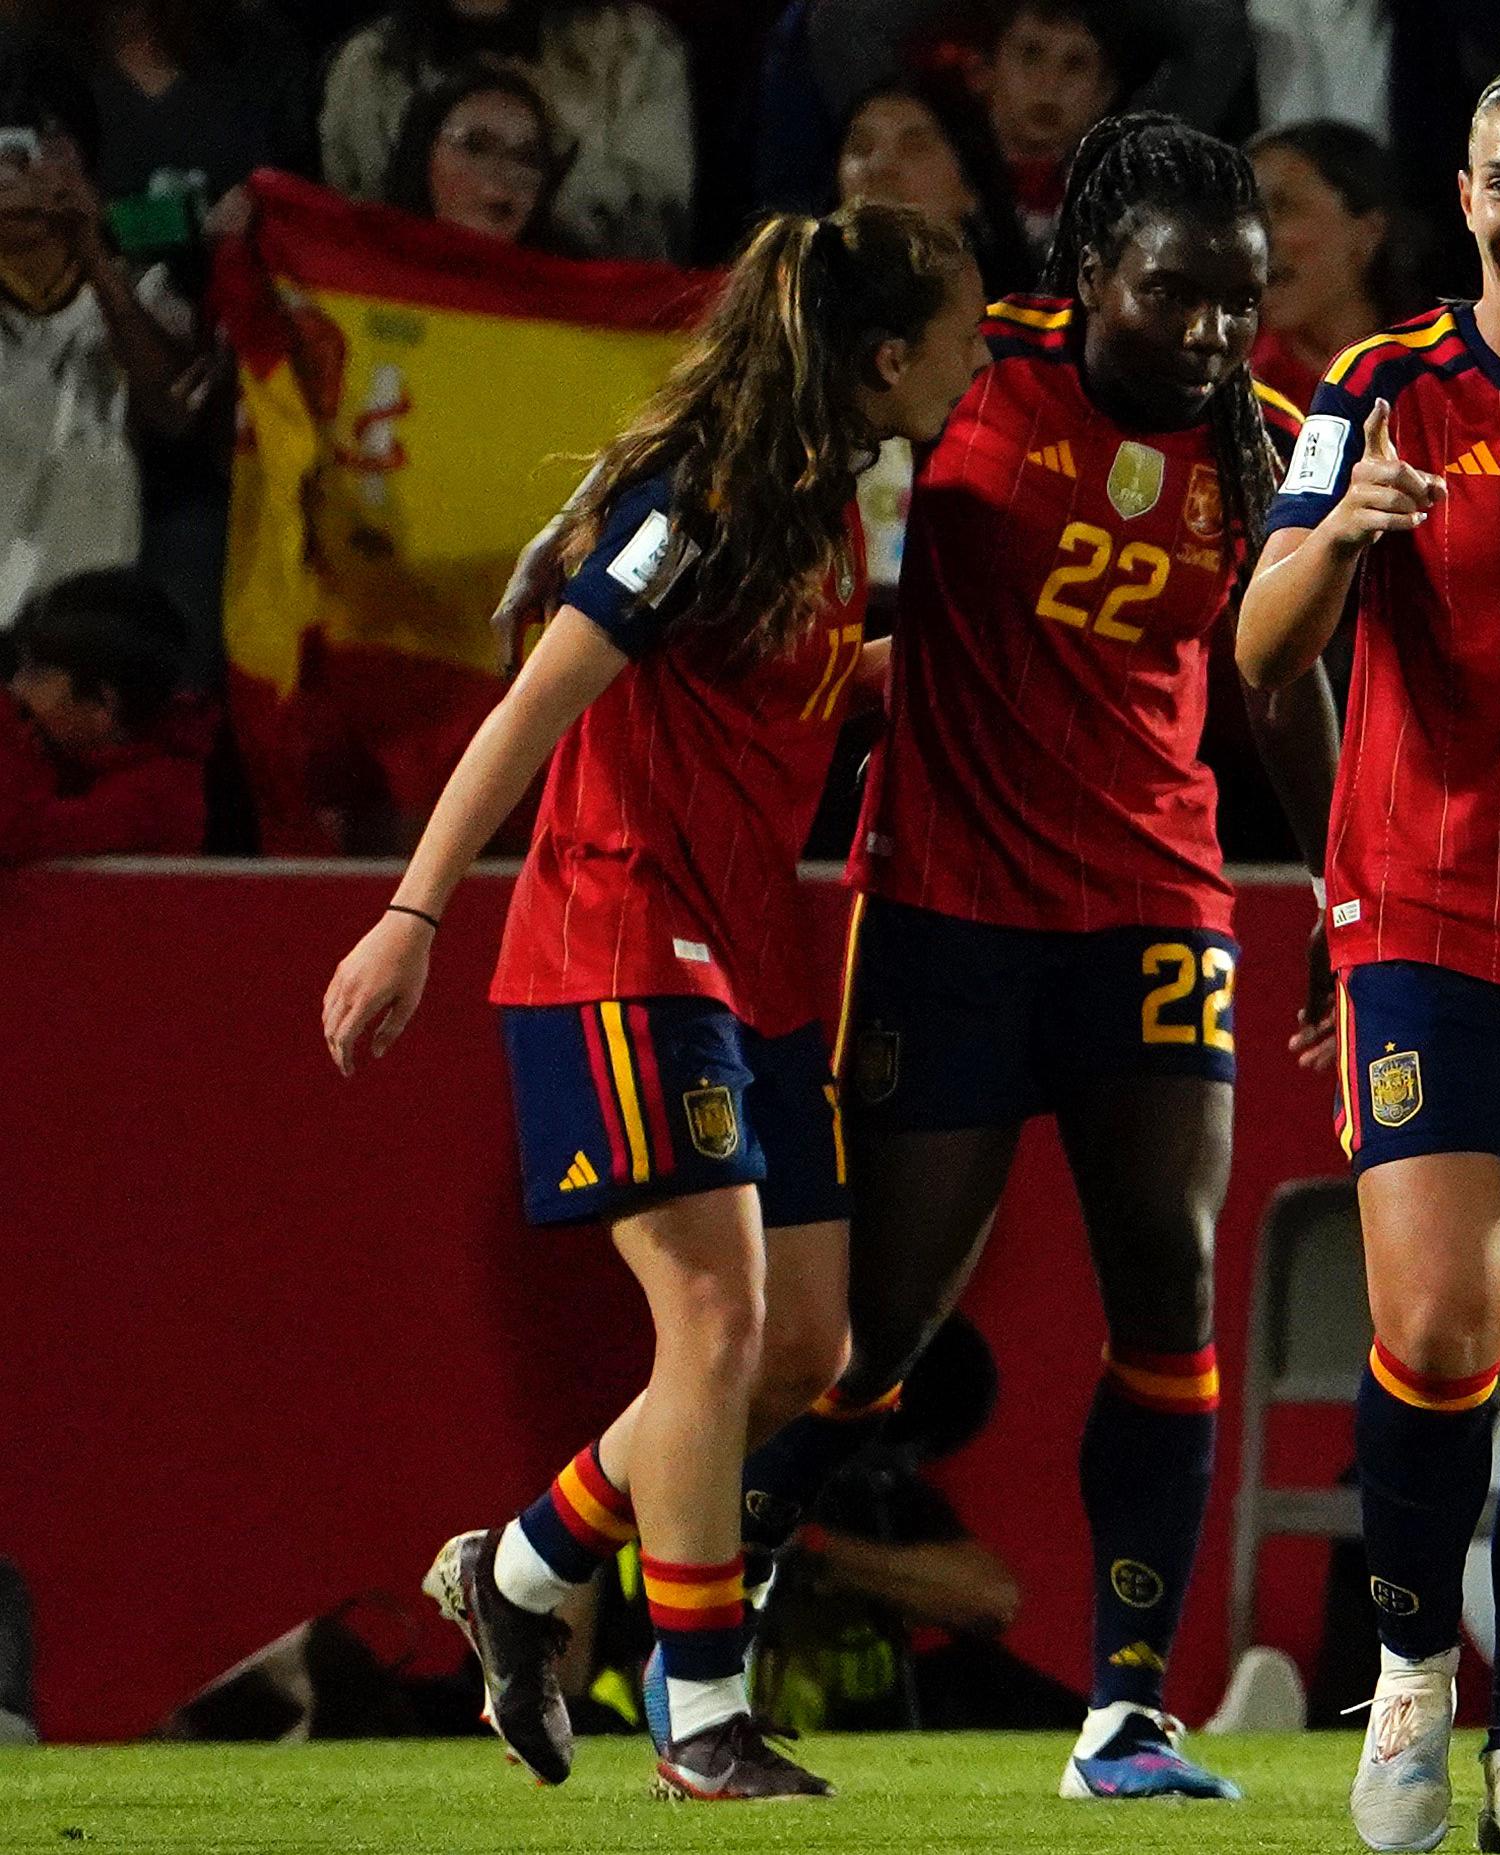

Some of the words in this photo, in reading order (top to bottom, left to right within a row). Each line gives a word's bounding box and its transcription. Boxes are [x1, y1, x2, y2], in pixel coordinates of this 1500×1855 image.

[1035, 521, 1171, 642] 22
[800, 623, 863, 721] 17
[1142, 943, 1237, 1056] 22
